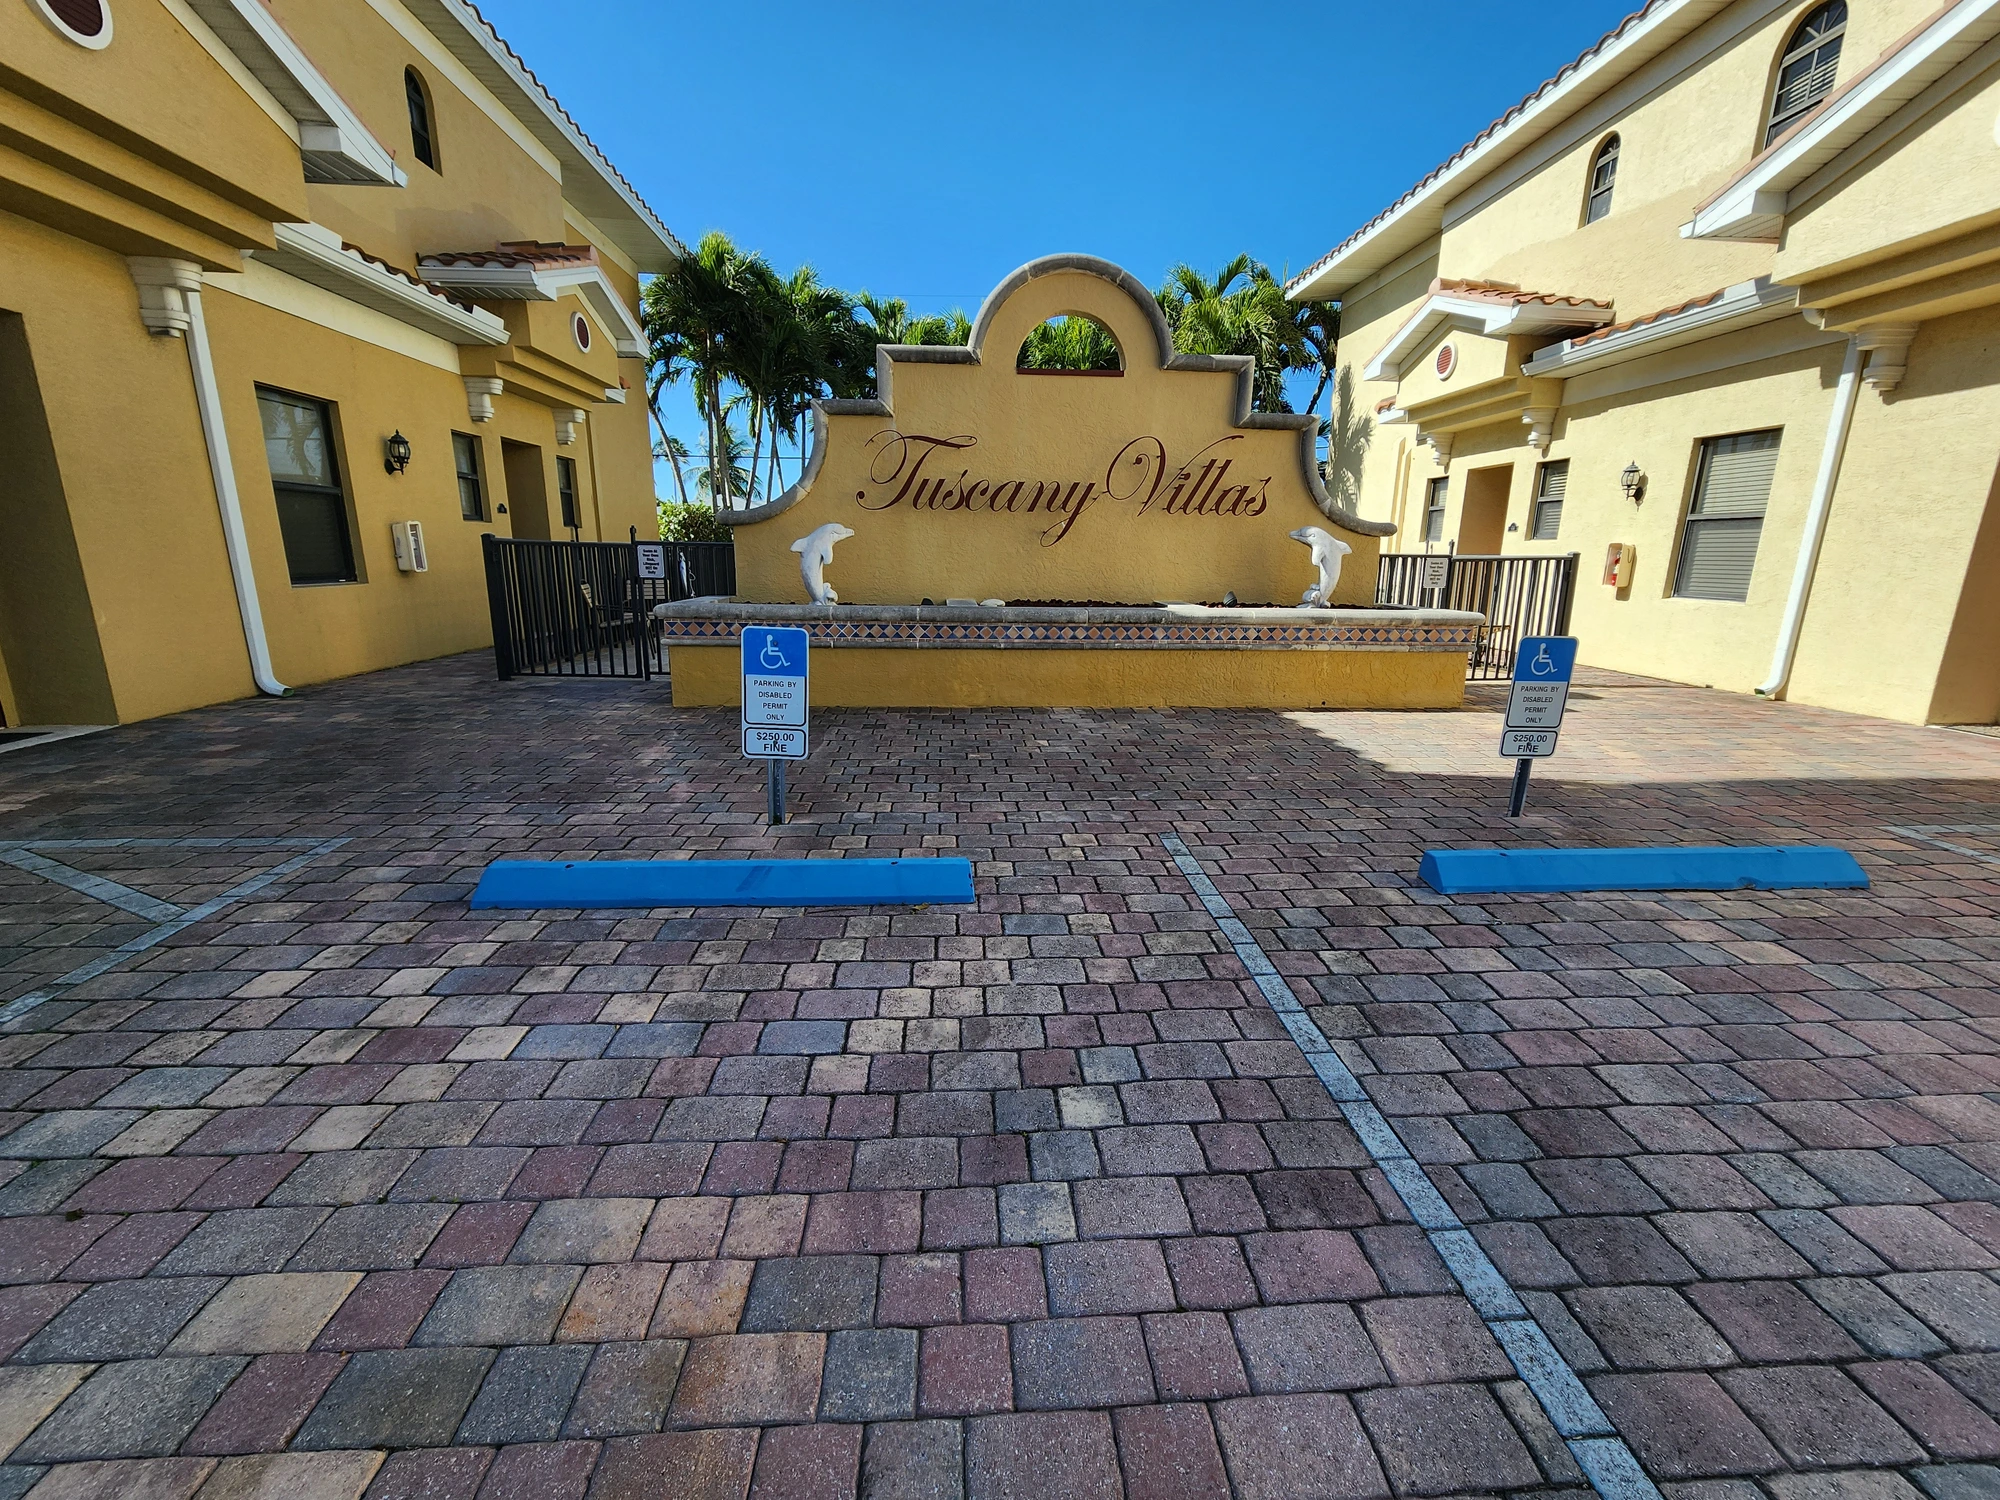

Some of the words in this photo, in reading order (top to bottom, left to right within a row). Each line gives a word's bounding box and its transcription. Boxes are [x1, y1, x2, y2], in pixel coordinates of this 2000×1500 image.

[856, 429, 1101, 548] Tuscany
[1102, 434, 1272, 517] Villas
[753, 679, 785, 688] PARKING
[1520, 685, 1548, 693] PARKING
[758, 691, 793, 699] DISABLED
[762, 702, 788, 710] PERMIT
[766, 713, 785, 721] ONLY
[756, 731, 795, 742] $250.00
[1512, 734, 1548, 743] $250.00
[763, 743, 787, 753] FINE
[1517, 745, 1539, 753] FINE
